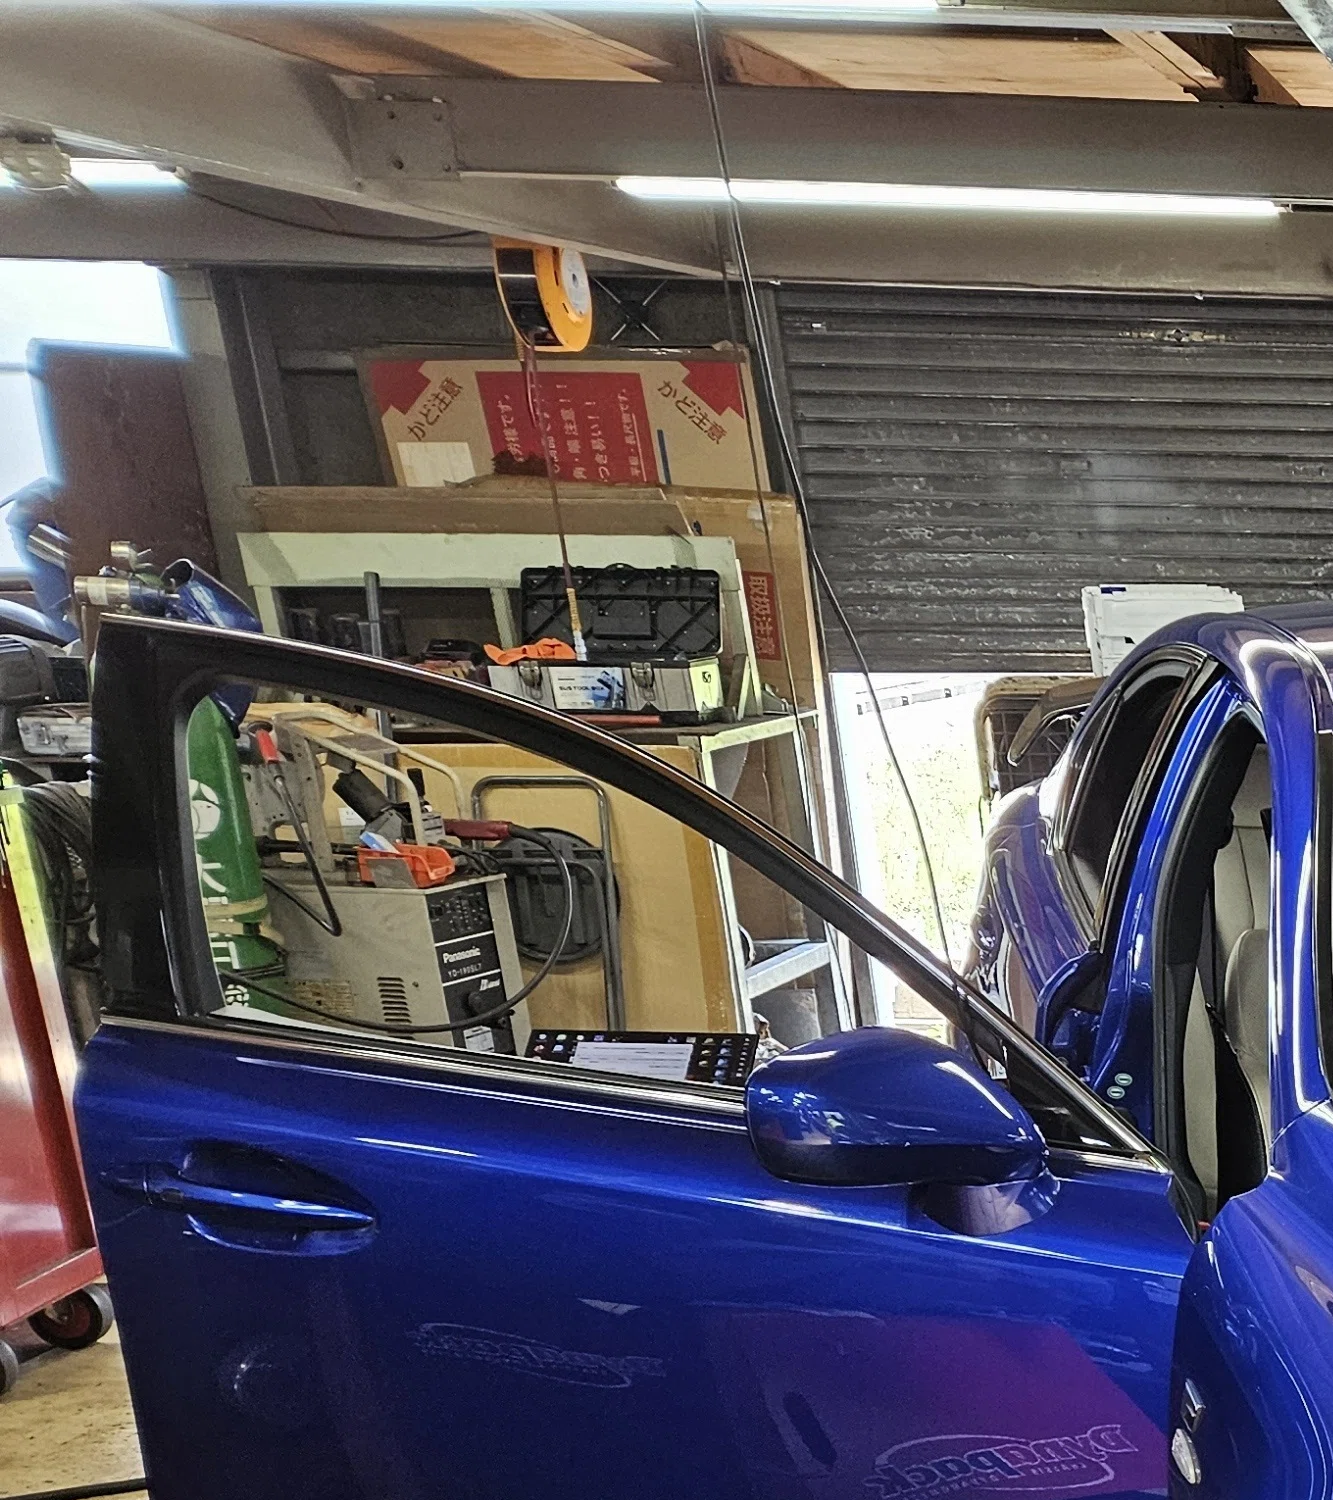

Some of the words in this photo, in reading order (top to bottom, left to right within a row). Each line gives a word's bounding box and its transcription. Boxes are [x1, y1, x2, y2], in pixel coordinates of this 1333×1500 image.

[407, 377, 463, 441] かど注意
[658, 381, 727, 444] かど注意
[749, 575, 775, 656] 取扱注意
[443, 946, 481, 964] Panasonic
